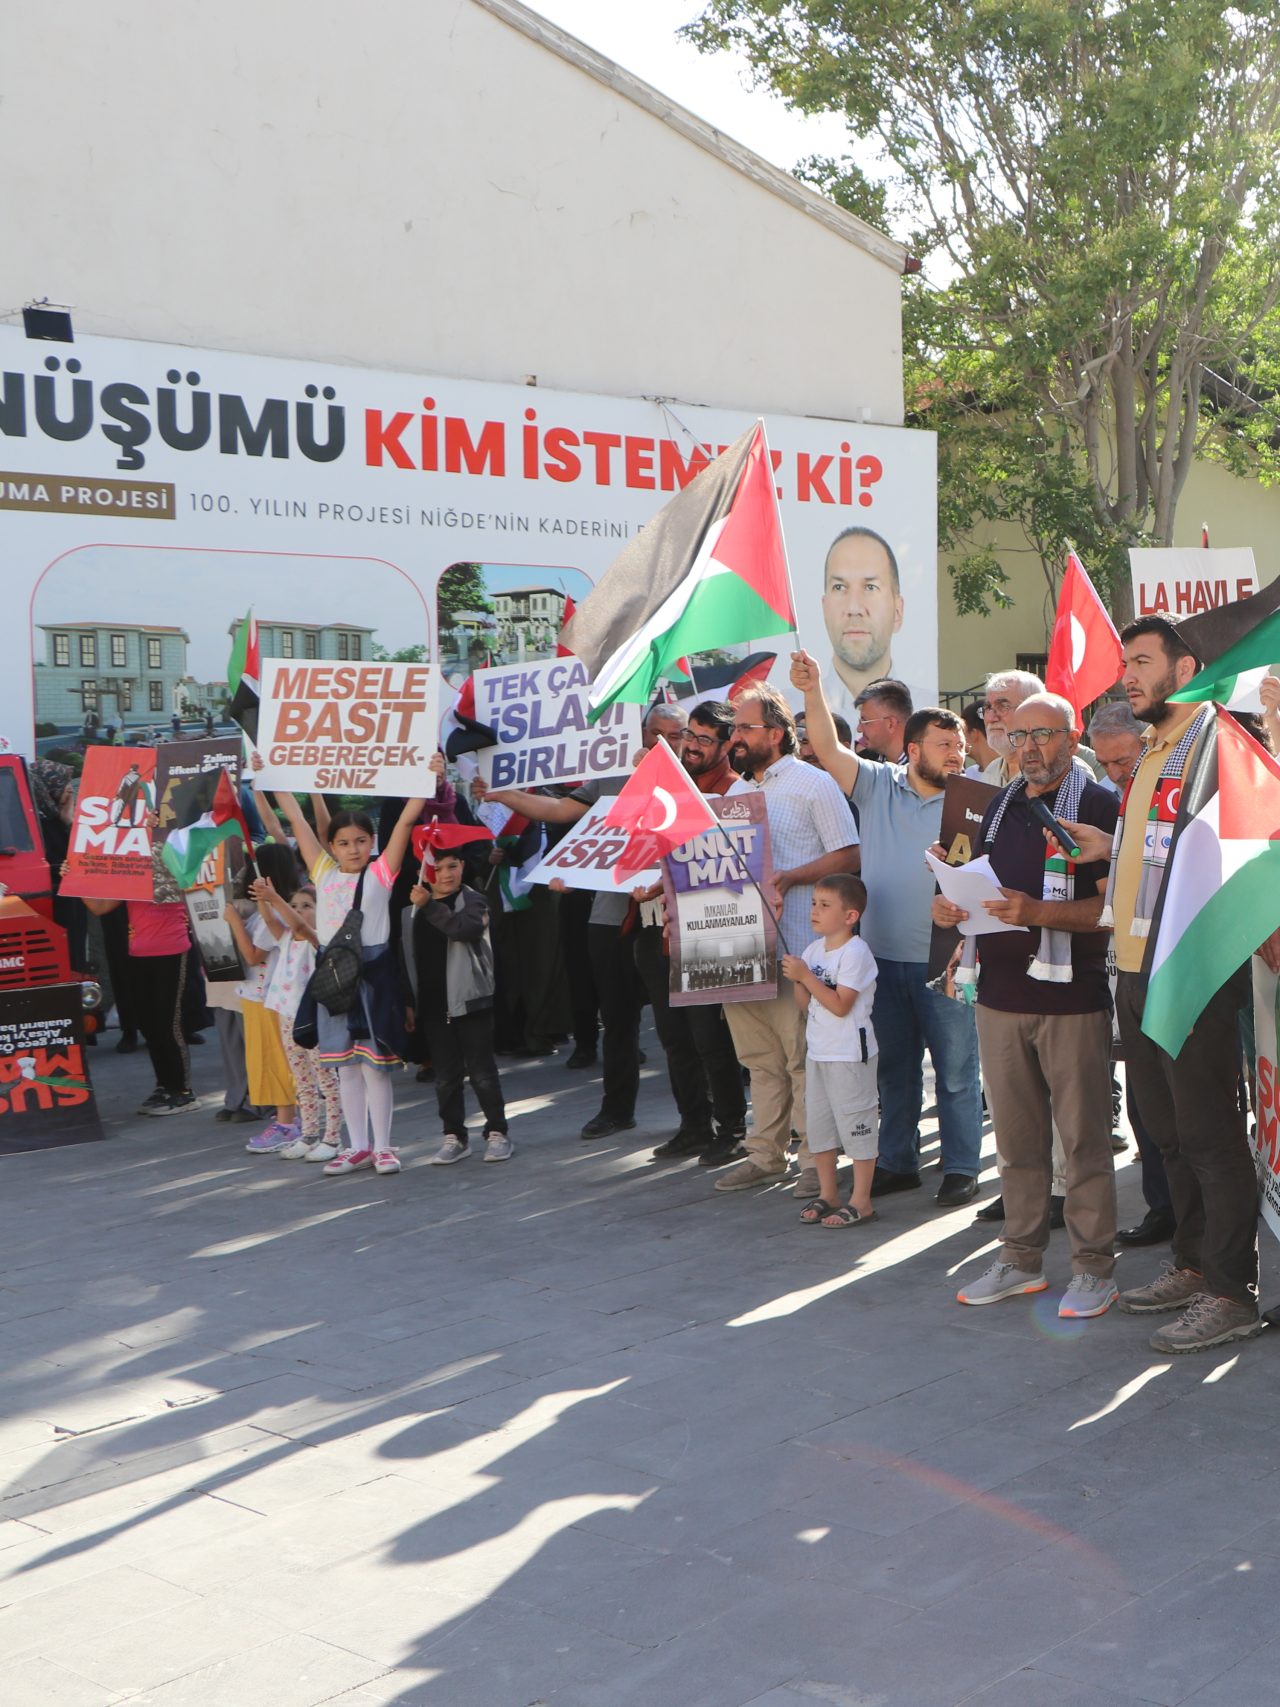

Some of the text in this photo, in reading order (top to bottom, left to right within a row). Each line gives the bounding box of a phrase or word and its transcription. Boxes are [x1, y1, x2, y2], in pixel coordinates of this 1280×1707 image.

[365, 397, 505, 476] KİM
[797, 441, 884, 507] Kİ?
[0, 481, 168, 509] MA PROJESİ
[190, 493, 238, 514] 100.
[249, 498, 308, 518] YILIN
[318, 502, 411, 525] PROJESİ
[420, 507, 530, 532] NİĞDE'NİN
[538, 517, 629, 539] KADERİNİ
[1140, 582, 1169, 615] LA
[272, 667, 430, 700] MESELE
[484, 669, 542, 703] TEK
[268, 744, 424, 767] GEBERECEK-
[77, 795, 152, 827] SU
[73, 825, 153, 856] MA
[671, 828, 757, 862] UNUT
[687, 854, 749, 887] MA!
[686, 914, 757, 931] KULLANMAYANLARI
[0, 956, 25, 968] MC
[14, 1028, 61, 1041] Aksa'yı
[20, 1018, 72, 1031] duaların
[17, 1037, 48, 1049] gece
[50, 1036, 74, 1045] Her
